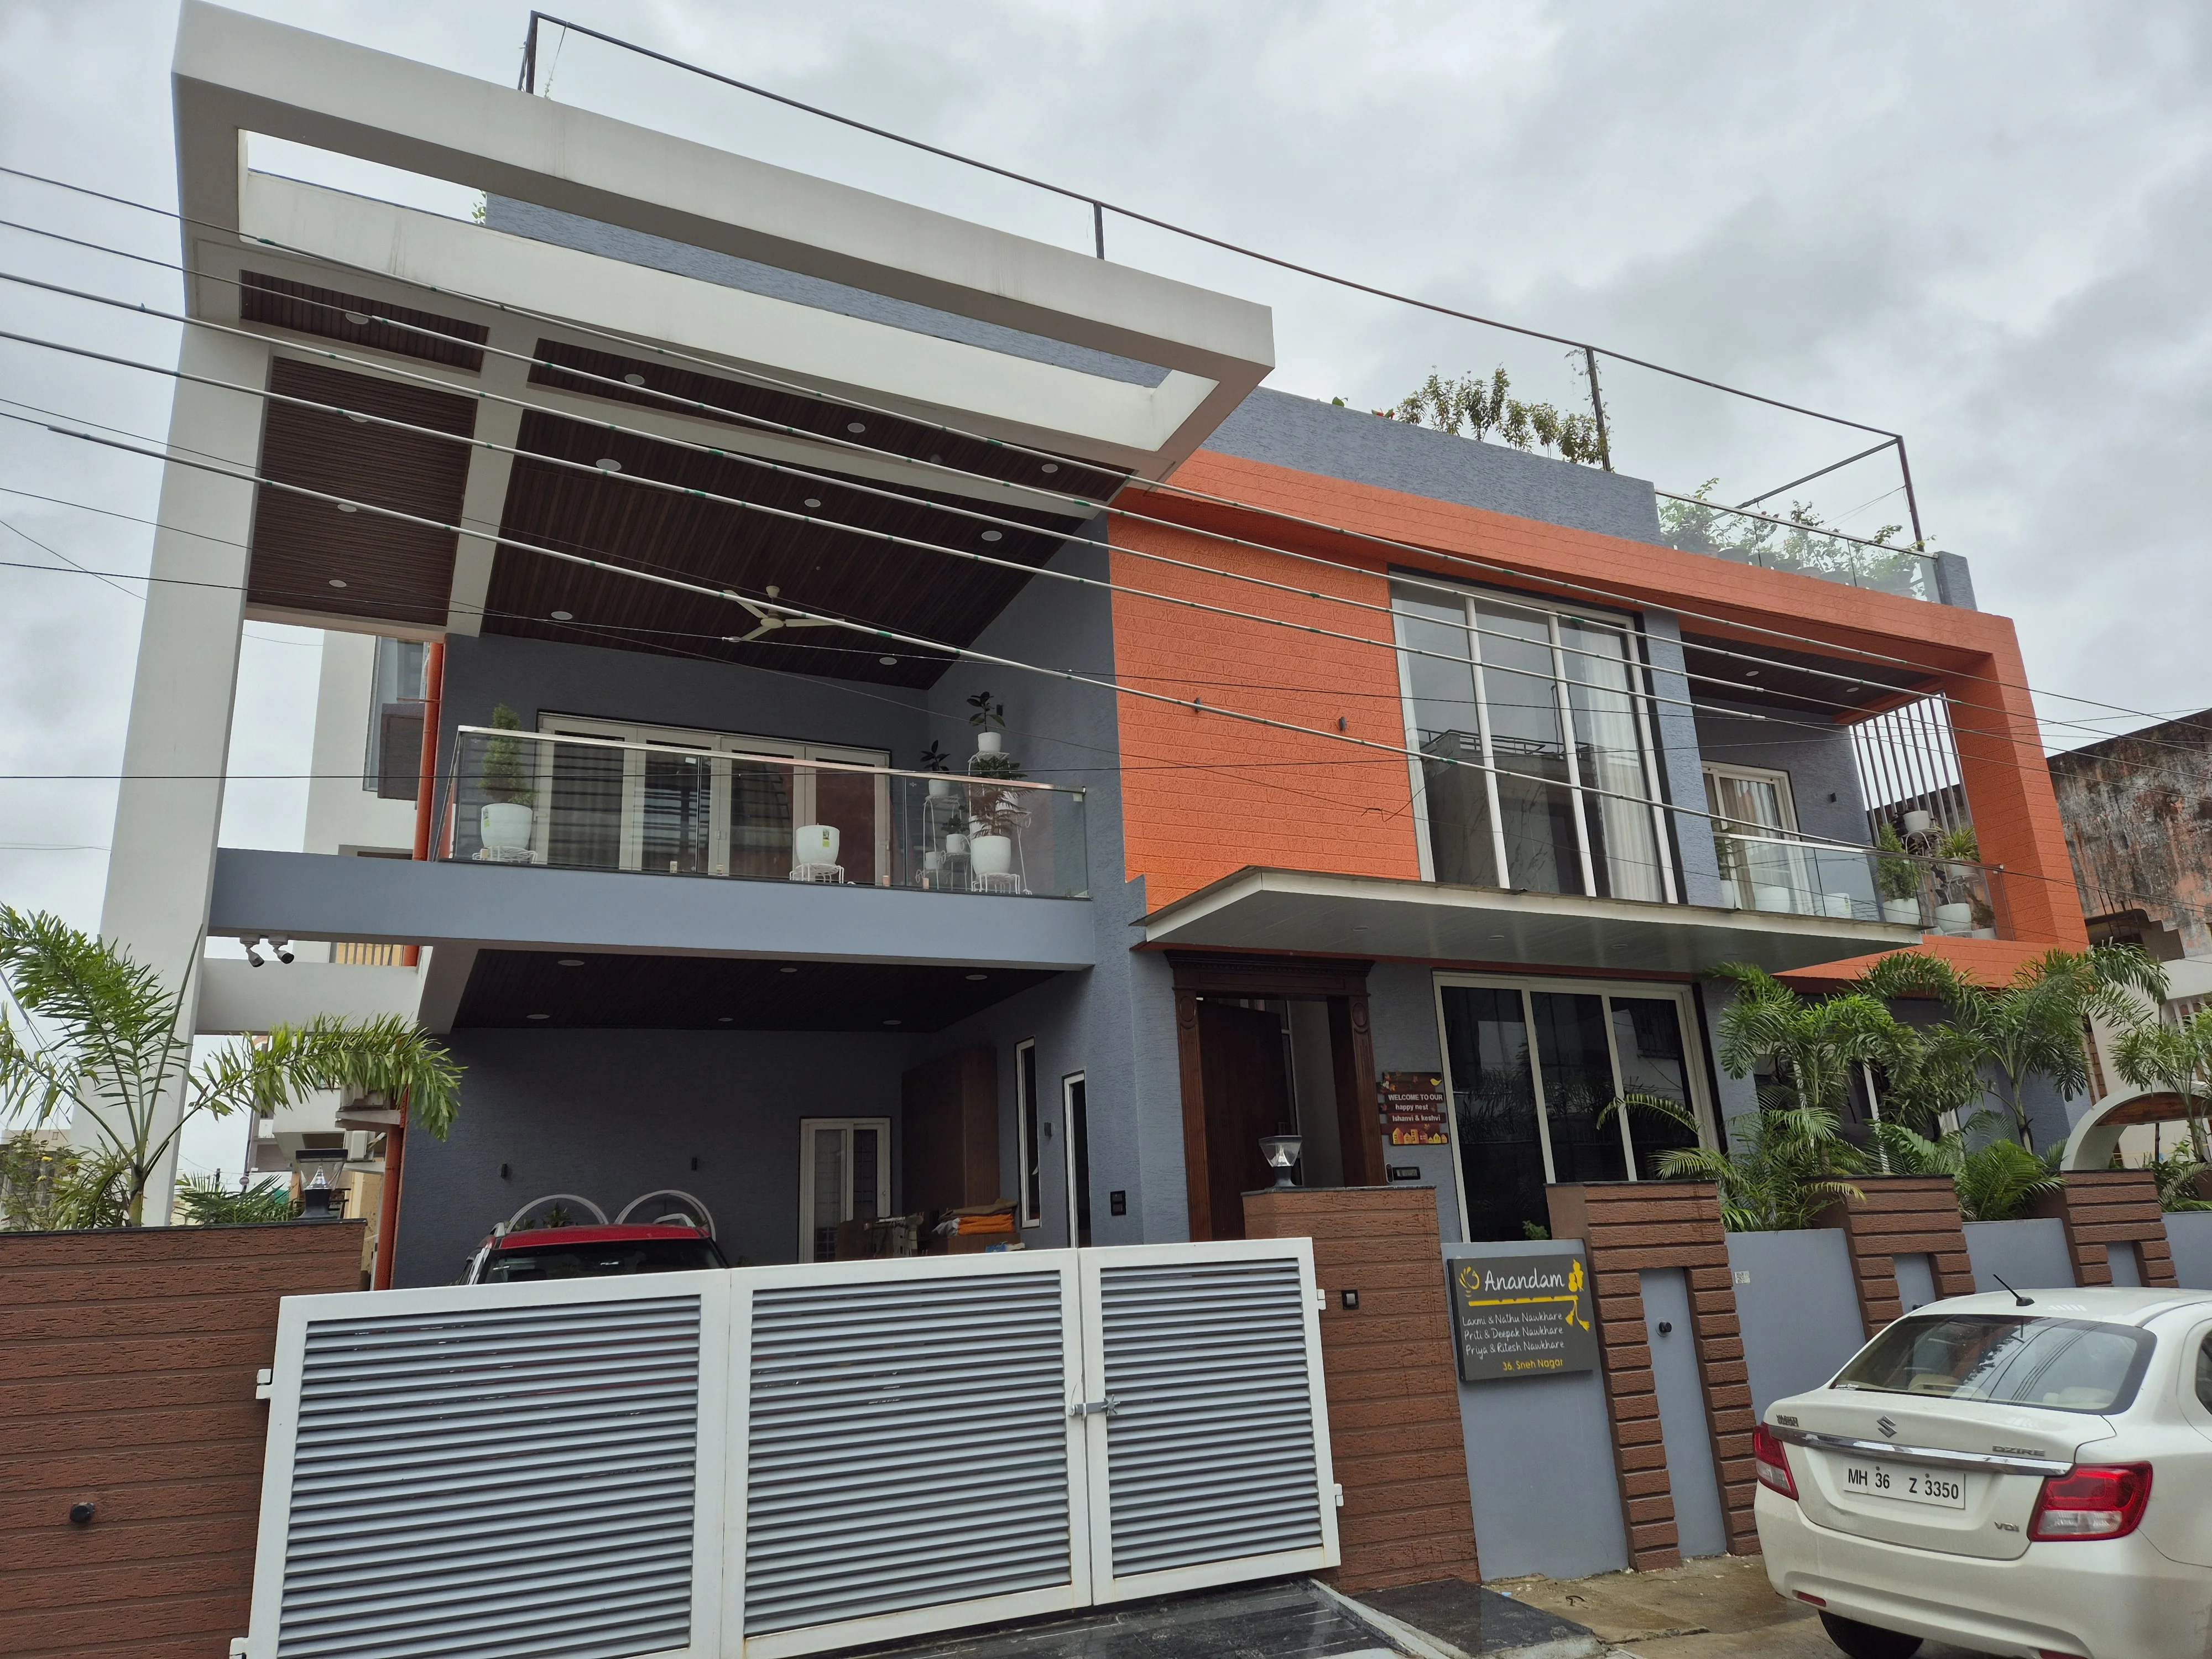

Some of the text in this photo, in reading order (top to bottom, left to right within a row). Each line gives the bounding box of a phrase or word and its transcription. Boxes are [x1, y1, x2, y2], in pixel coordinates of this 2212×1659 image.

[1485, 1267, 1565, 1291] Anandam
[1462, 1311, 1563, 1326] Laxmi & Nathu Nawkhare
[1464, 1325, 1563, 1342] Priti & Deepak Nawkhare
[1466, 1339, 1564, 1360] Priya & Ritesh Nawkhare
[1516, 1360, 1536, 1370] Sneh
[1537, 1359, 1563, 1369] Nagar
[1992, 1445, 2046, 1456] DZIRE
[1848, 1468, 1959, 1500] MH 36 Z 3350
